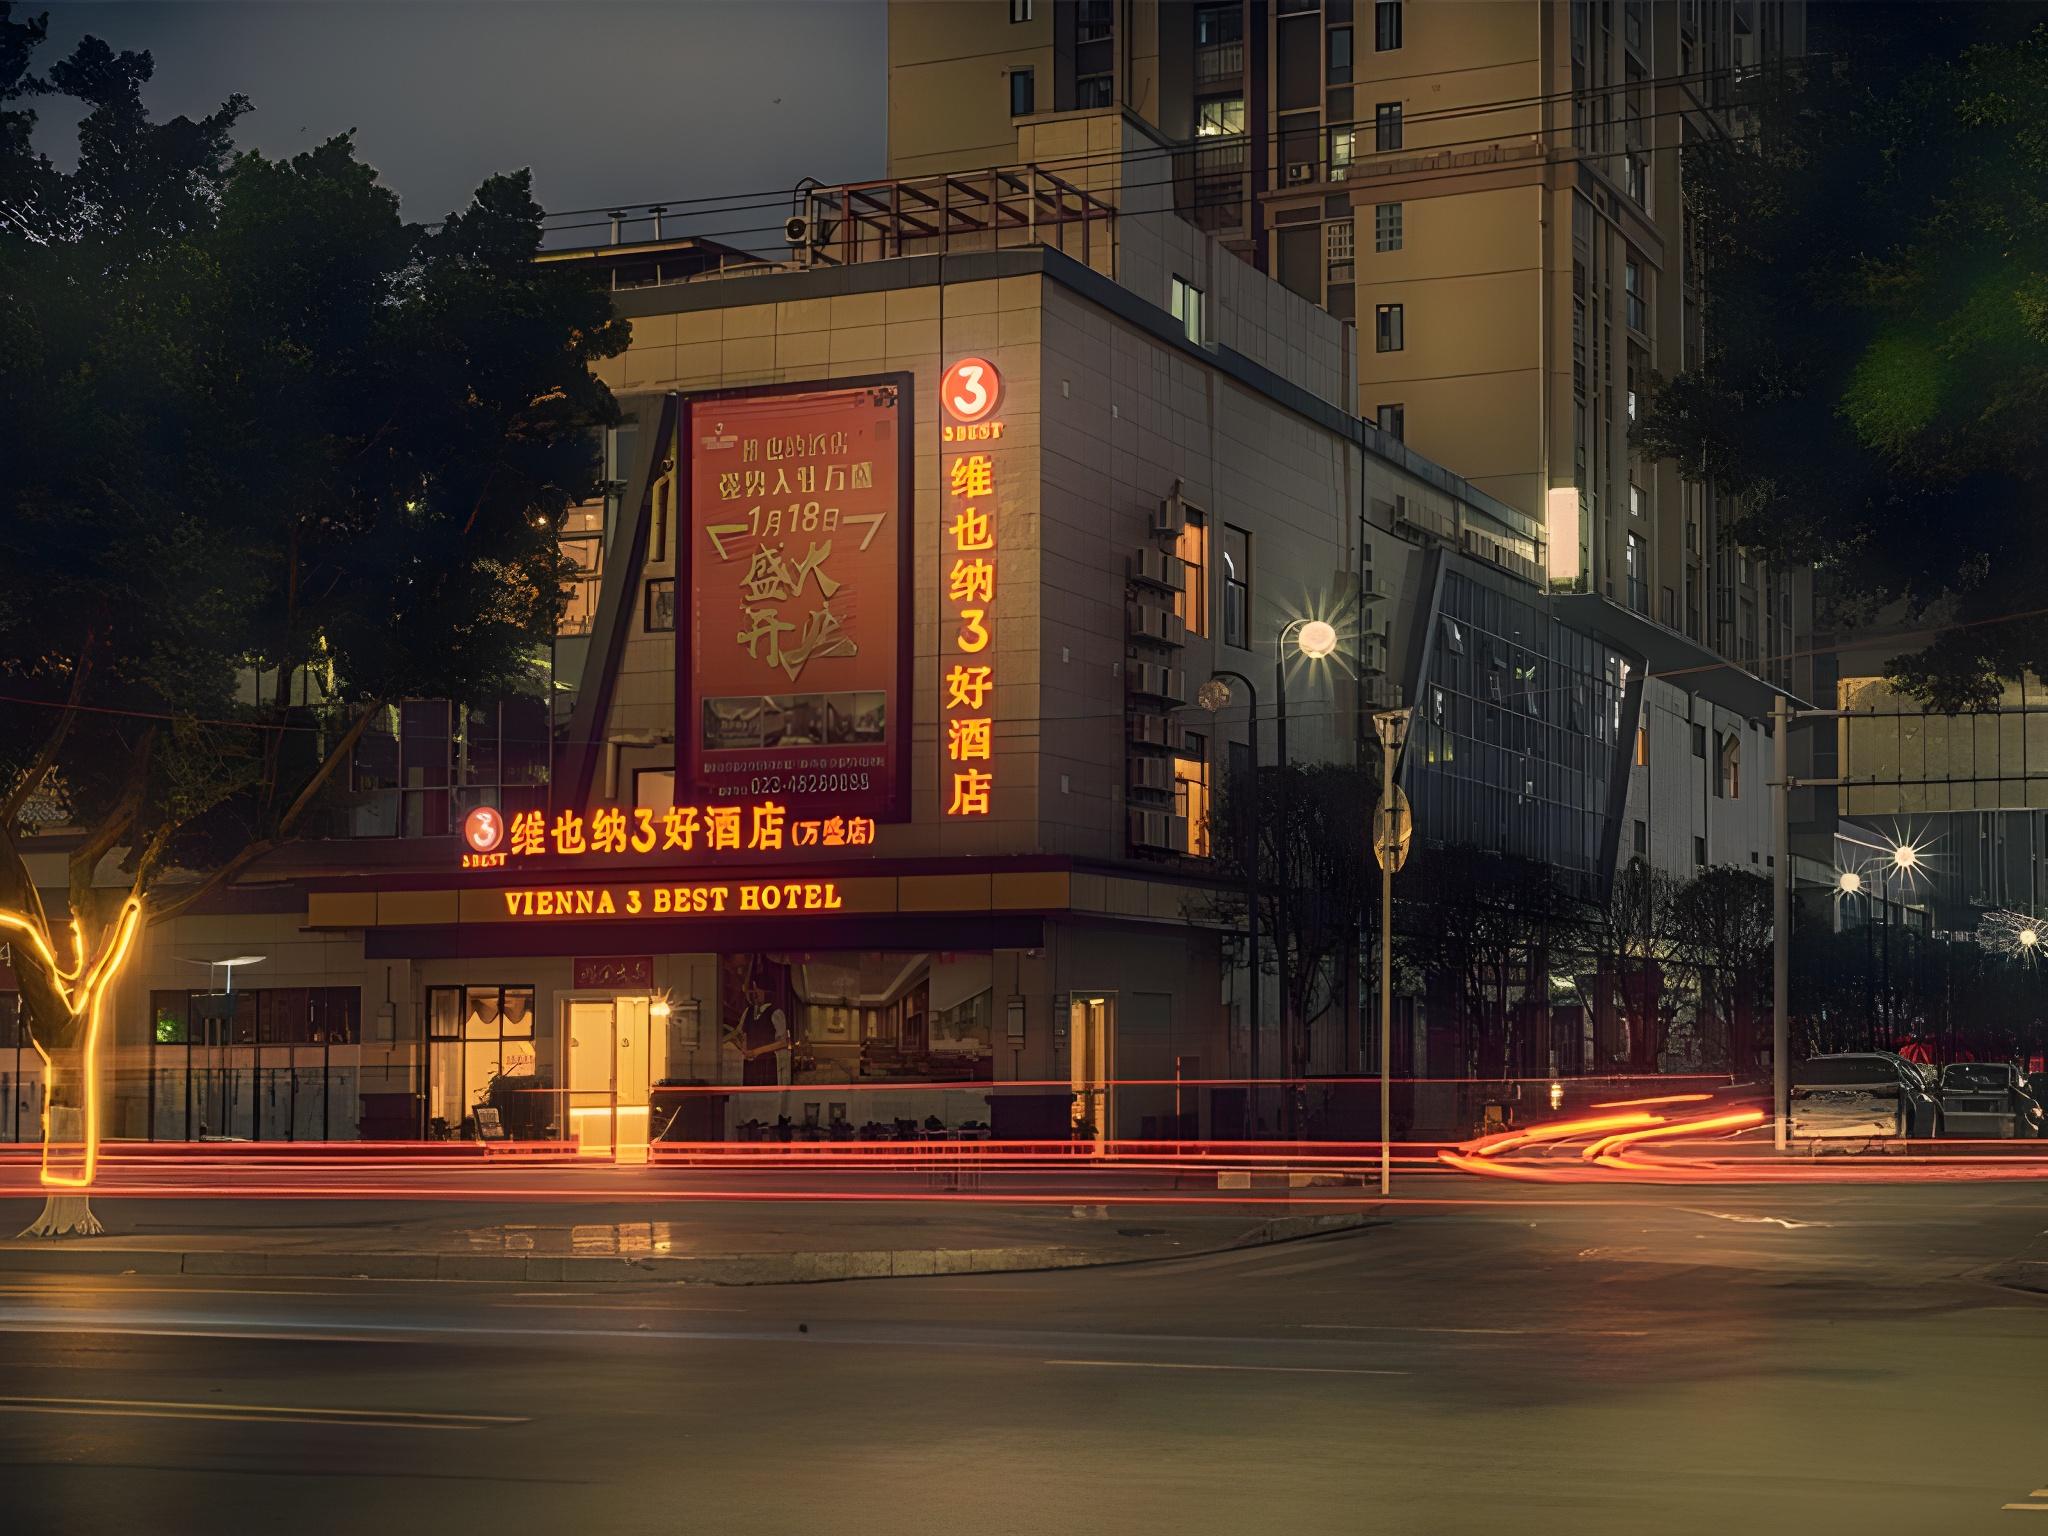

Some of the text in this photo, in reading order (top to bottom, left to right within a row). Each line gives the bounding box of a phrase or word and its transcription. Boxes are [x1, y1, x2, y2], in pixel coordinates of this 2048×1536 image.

[953, 365, 988, 415] 3
[747, 501, 840, 538] 1月18日
[946, 454, 994, 816] 维也纳3好酒店
[510, 801, 875, 856] 维也纳3好酒店 (万盛店)
[504, 883, 842, 916] VIENNA 3 BEST HOTEL
